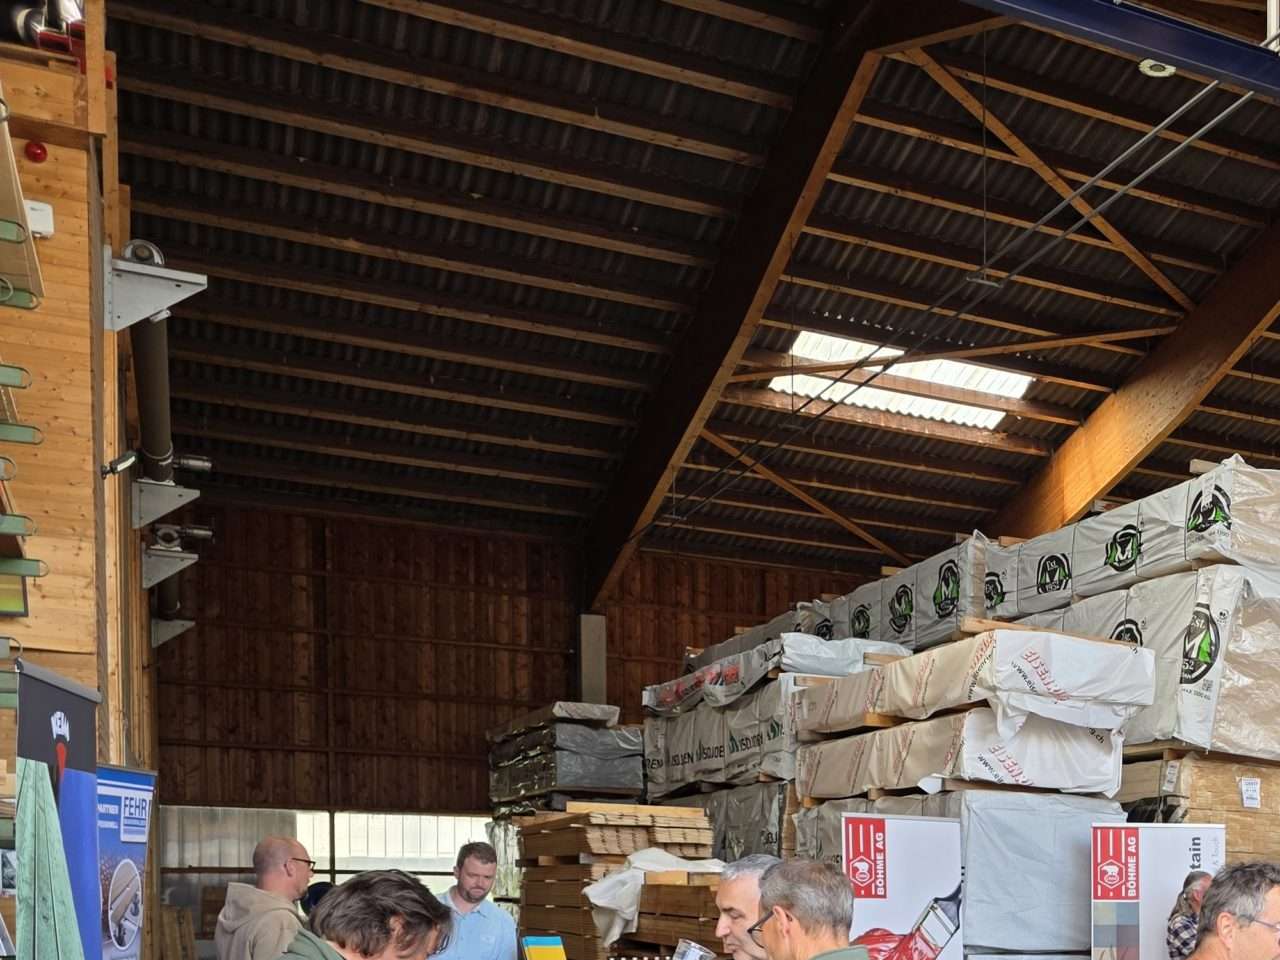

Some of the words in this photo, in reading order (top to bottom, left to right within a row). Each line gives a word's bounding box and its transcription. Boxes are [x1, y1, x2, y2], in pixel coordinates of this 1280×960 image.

[123, 796, 147, 817] FEHR
[875, 832, 884, 849] AG
[1128, 836, 1137, 852] AG
[1189, 836, 1202, 870] tain
[1126, 855, 1137, 897] BÖHME
